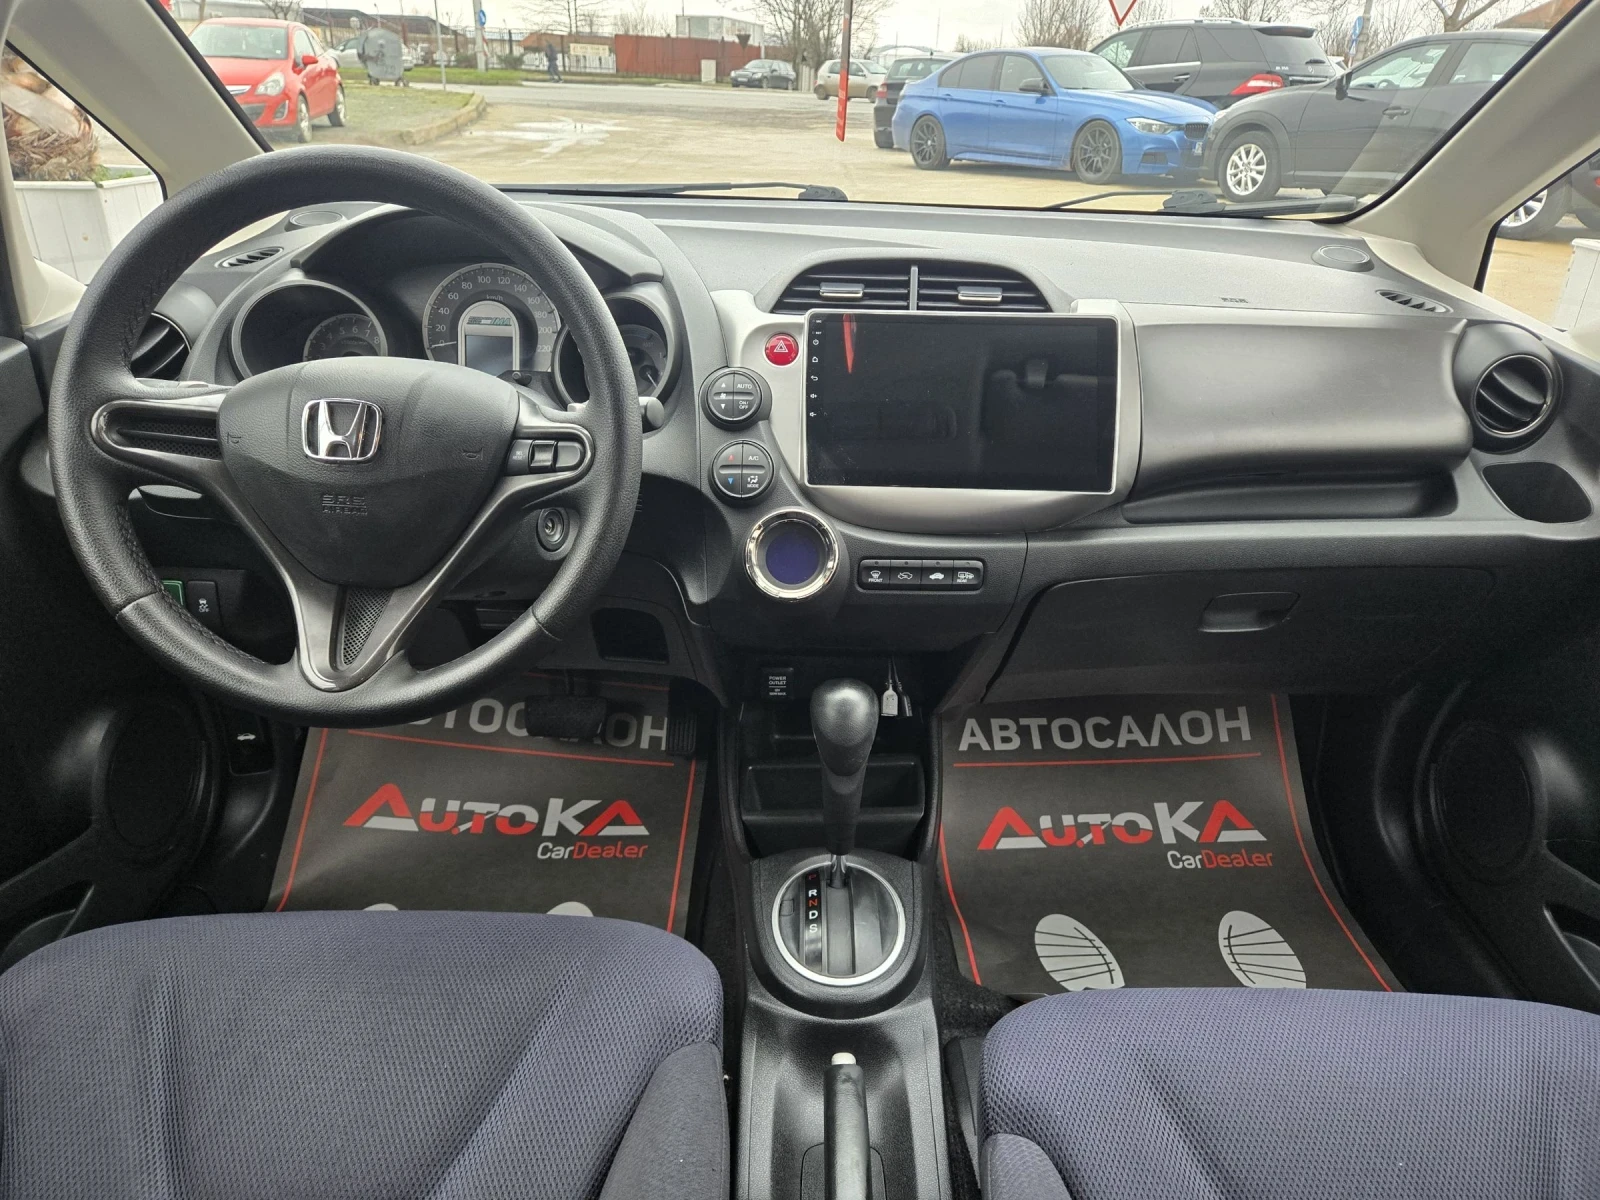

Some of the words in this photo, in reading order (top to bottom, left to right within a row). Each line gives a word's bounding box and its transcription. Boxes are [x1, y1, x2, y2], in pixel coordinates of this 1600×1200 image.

[477, 276, 491, 284] 100
[498, 276, 510, 284] 120
[461, 281, 473, 290] 80
[514, 284, 527, 293] 140
[448, 292, 459, 300] 60
[527, 296, 540, 305] 160
[438, 307, 450, 315] 40
[534, 311, 547, 319] 180
[352, 325, 358, 334] 6
[435, 324, 446, 332] 20
[538, 326, 551, 334] 200
[364, 329, 370, 337] 7
[373, 336, 380, 344] 8
[537, 345, 551, 353] 220
[958, 705, 1252, 751] АВТОСАЛОН
[536, 840, 649, 860] CarDealer
[1167, 848, 1273, 869] CarDealer
[808, 889, 817, 897] R
[808, 898, 818, 907] N
[808, 910, 818, 920] D
[809, 923, 818, 933] S
